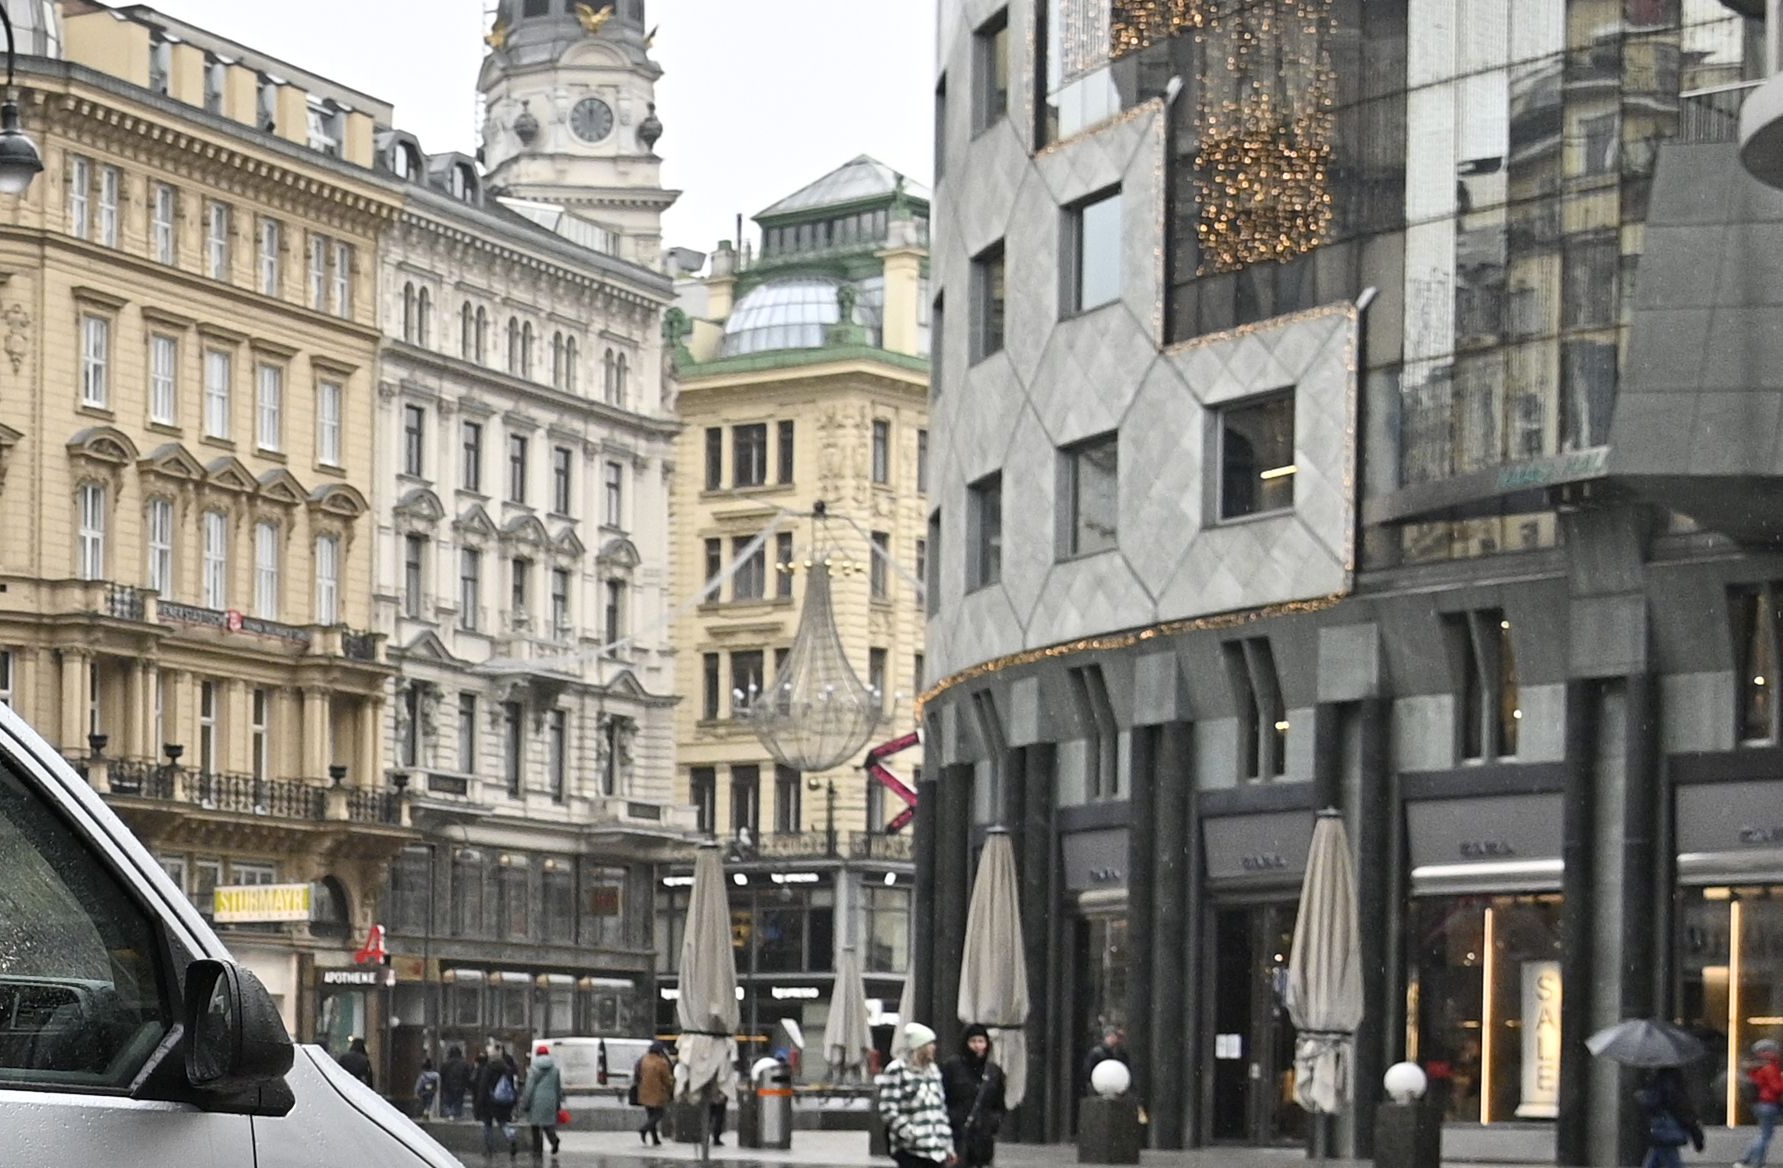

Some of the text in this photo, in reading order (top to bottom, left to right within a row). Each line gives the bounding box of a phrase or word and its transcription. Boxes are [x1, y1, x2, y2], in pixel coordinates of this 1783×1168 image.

[220, 888, 304, 912] STURMAYR
[324, 971, 376, 984] APOTHEKE
[1536, 975, 1554, 1092] SALE
